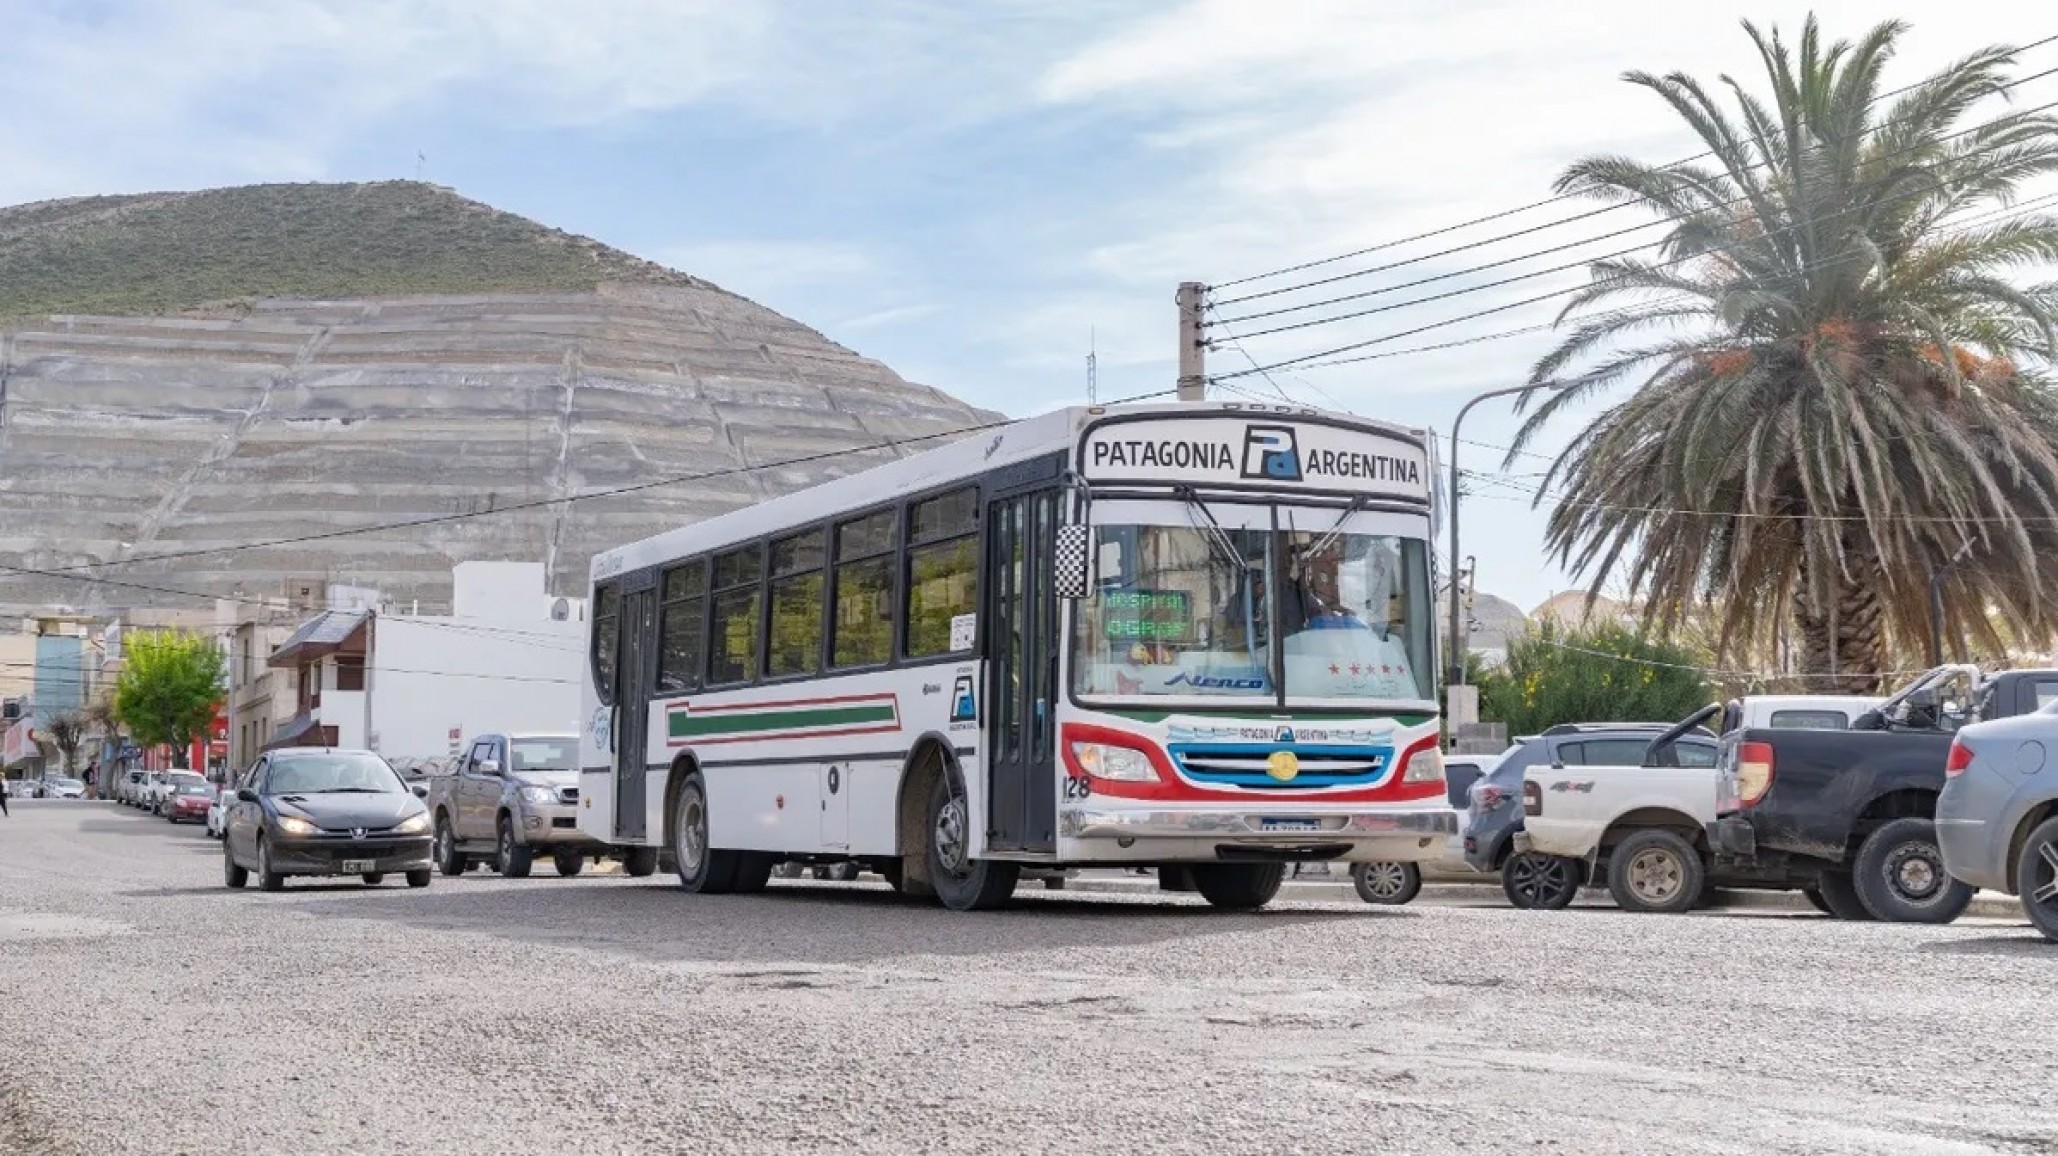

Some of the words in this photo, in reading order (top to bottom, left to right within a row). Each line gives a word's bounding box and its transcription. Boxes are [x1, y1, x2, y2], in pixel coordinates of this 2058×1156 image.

[1093, 440, 1235, 471] PATAGONIA
[1305, 448, 1420, 485] ARGENTINA
[1062, 775, 1091, 799] 128
